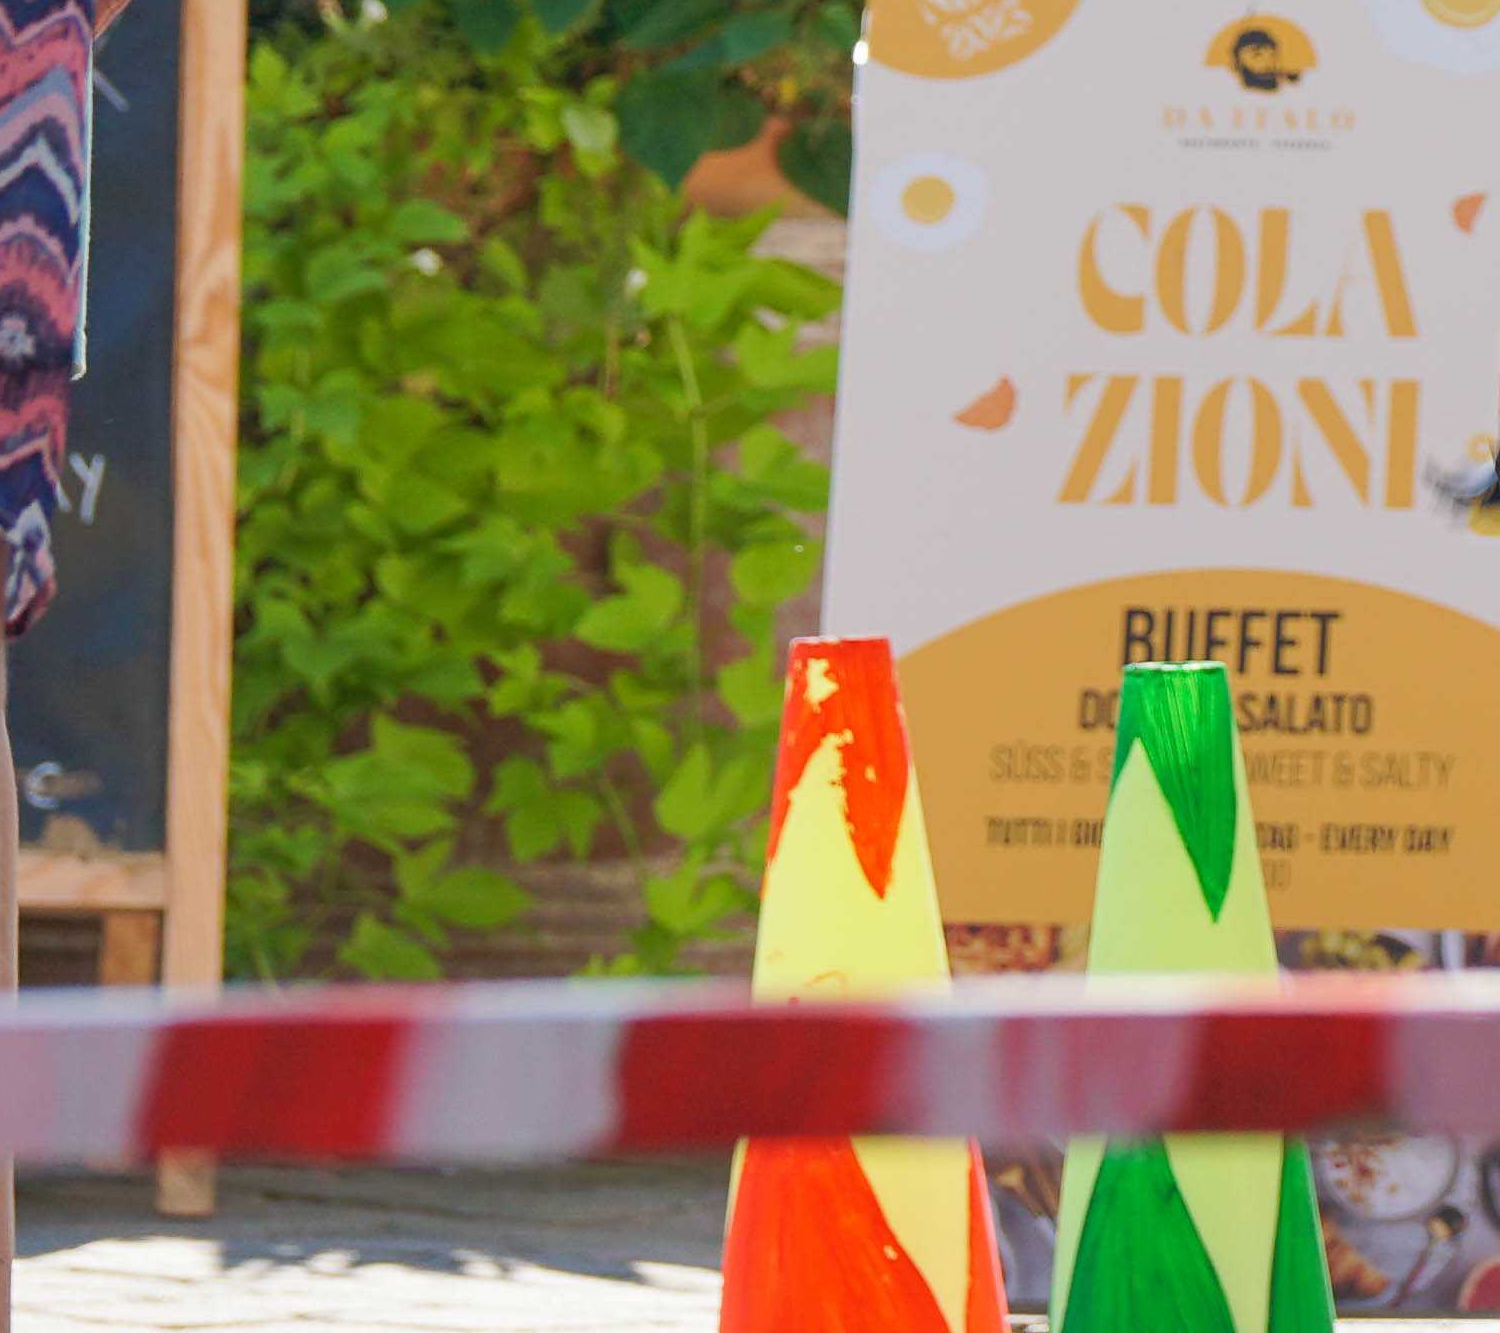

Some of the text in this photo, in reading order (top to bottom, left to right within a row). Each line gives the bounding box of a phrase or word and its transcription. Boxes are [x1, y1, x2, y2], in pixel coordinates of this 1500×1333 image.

[1076, 202, 1419, 337] COLA
[1055, 372, 1421, 510] ZIONI
[1122, 608, 1343, 678] BUFFET
[1237, 691, 1375, 736] SALATO
[1361, 751, 1457, 790] SALTY
[1319, 824, 1396, 852] EVERY
[1402, 825, 1455, 853] DAY
